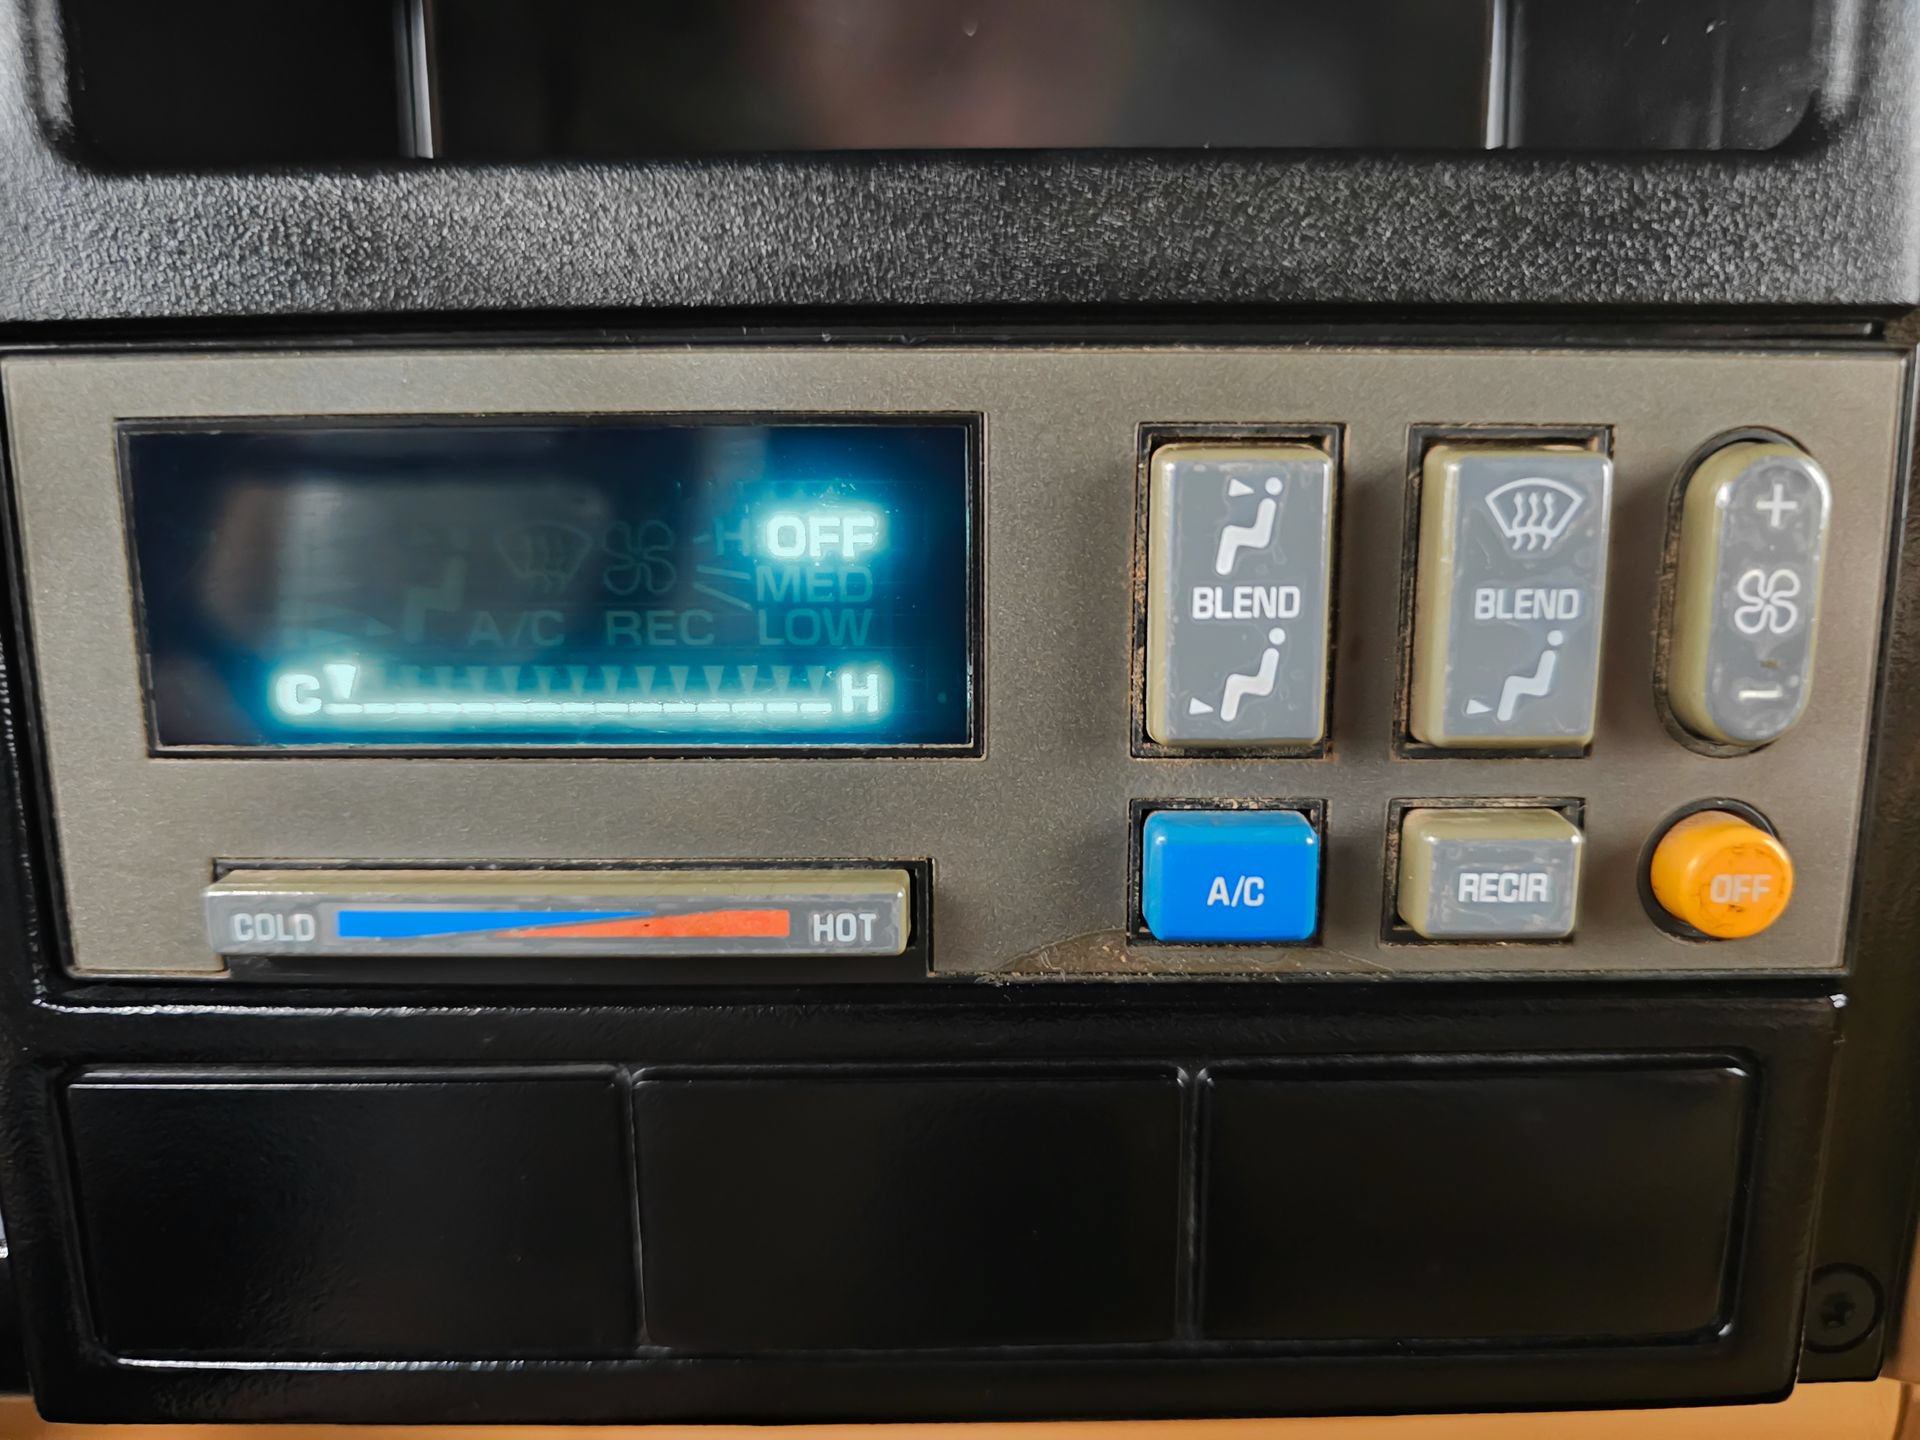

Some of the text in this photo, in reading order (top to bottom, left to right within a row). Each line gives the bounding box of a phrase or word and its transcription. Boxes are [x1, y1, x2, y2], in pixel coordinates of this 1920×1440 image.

[766, 515, 876, 558] OFF
[756, 565, 873, 602] MED
[1192, 586, 1301, 621] BLEND
[1474, 587, 1580, 621] BLEND
[468, 608, 873, 646] A/C REC LOW
[275, 674, 322, 715] C
[839, 672, 879, 714] H
[1207, 876, 1266, 908] A/C
[1458, 872, 1549, 904] RECIR
[1709, 874, 1771, 905] OFF
[233, 912, 316, 943] COLD
[812, 911, 877, 943] HOT
